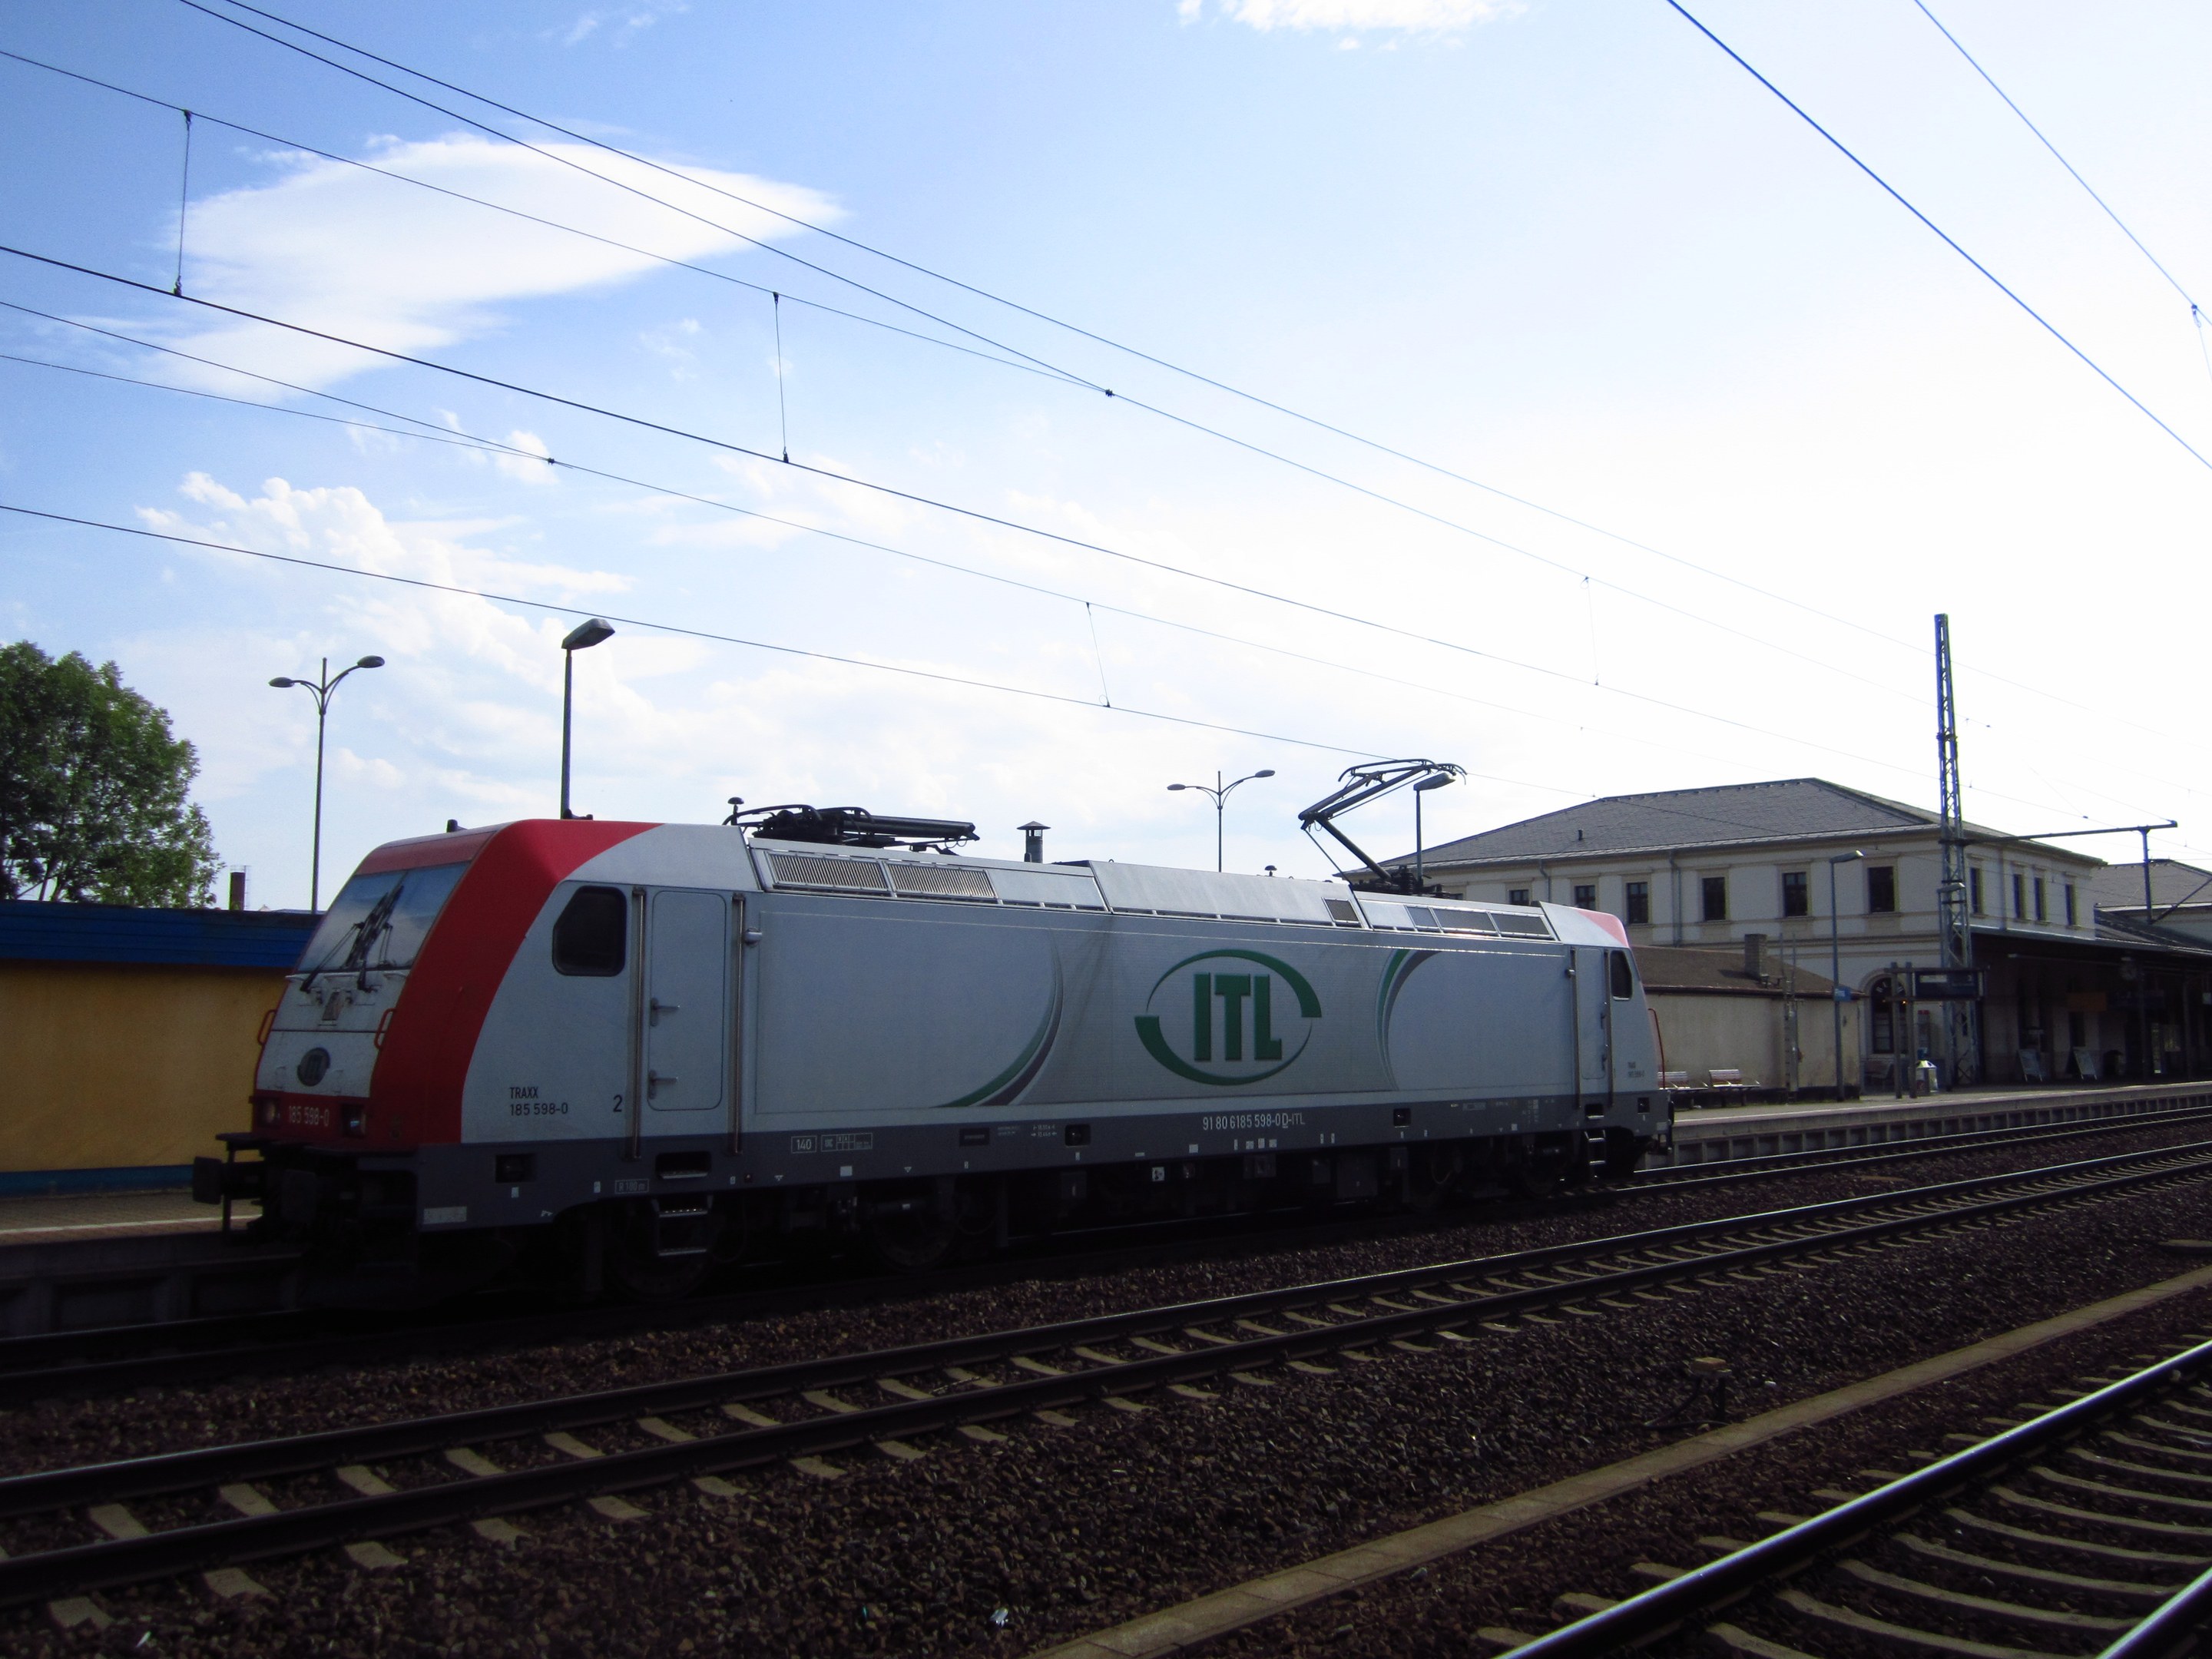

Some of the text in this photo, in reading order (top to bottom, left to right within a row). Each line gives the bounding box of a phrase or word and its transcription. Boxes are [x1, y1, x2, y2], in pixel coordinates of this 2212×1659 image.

[1194, 972, 1282, 1062] ITL
[509, 1087, 538, 1099] TRAXX
[510, 1102, 568, 1116] 185 598-0
[613, 1094, 623, 1112] 2
[289, 1105, 329, 1127] 185 598-0
[1202, 1116, 1213, 1131] 91
[1215, 1115, 1228, 1130] 80
[1230, 1114, 1253, 1129] 6185
[796, 1139, 812, 1150] 140
